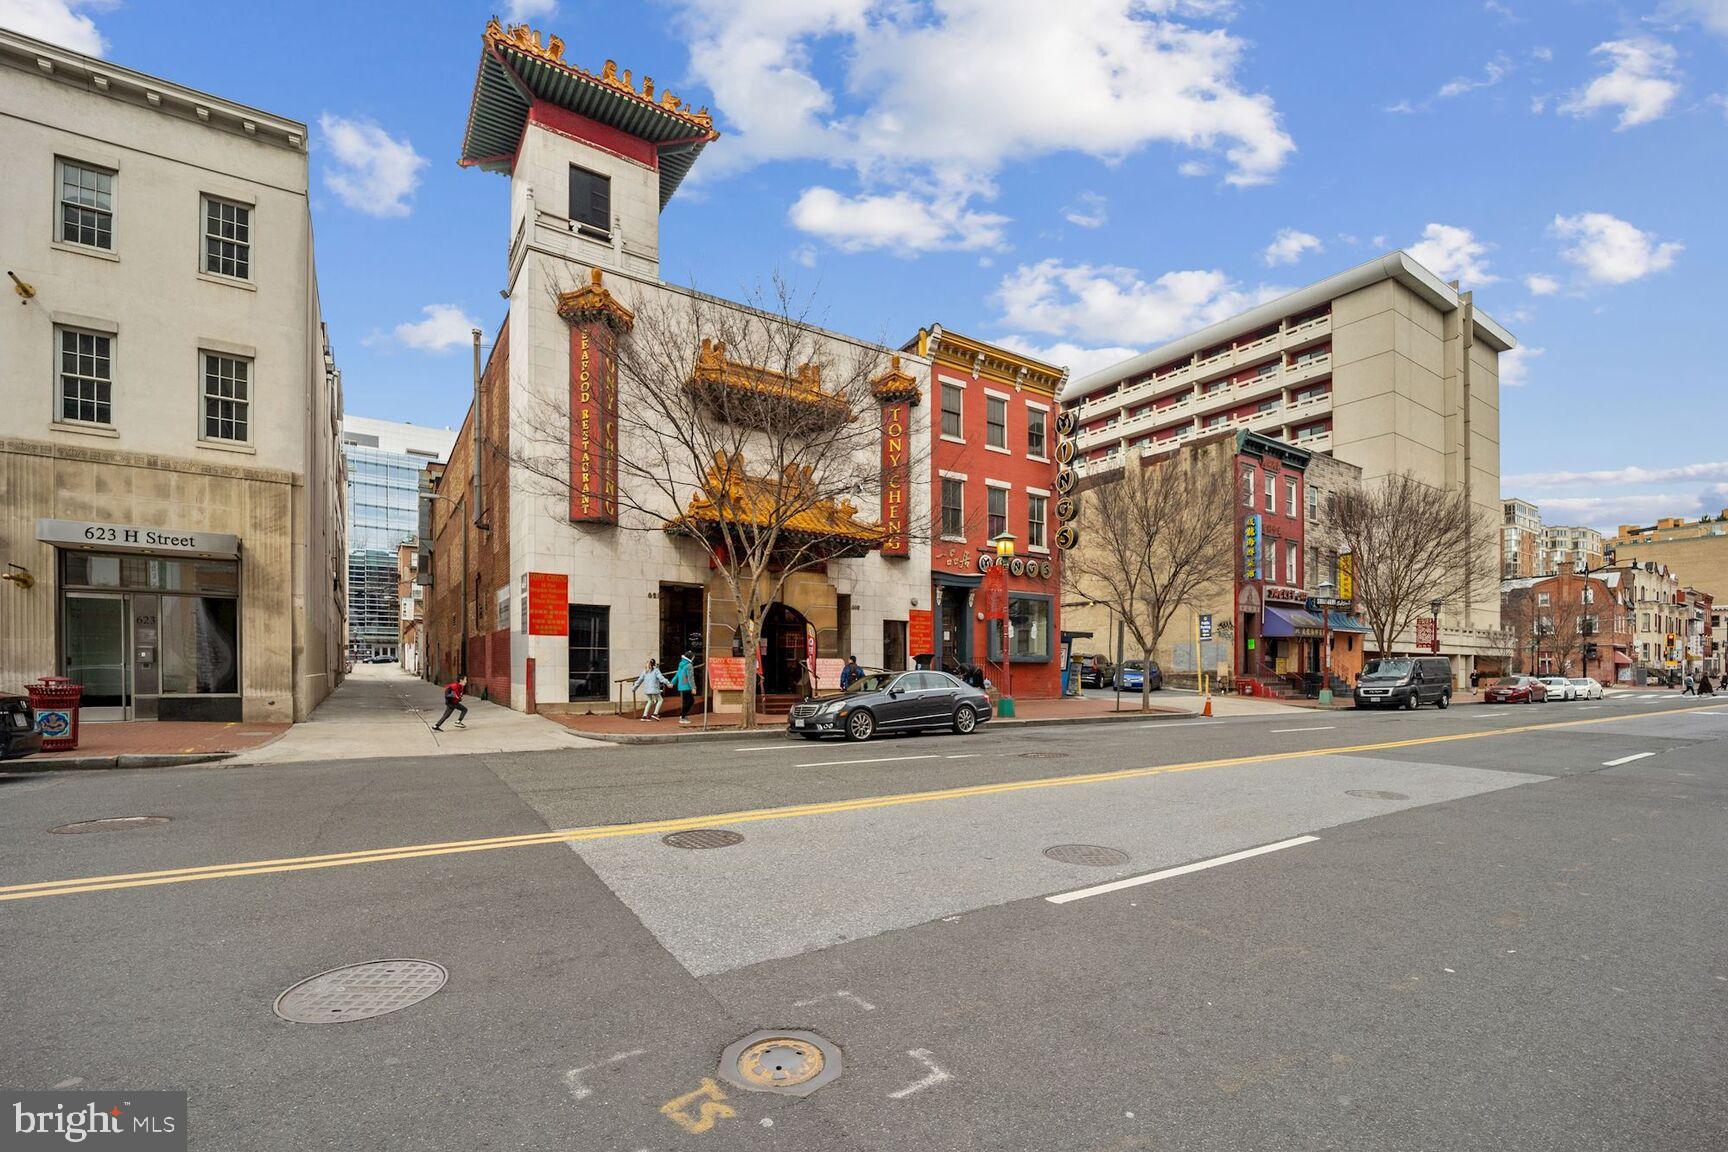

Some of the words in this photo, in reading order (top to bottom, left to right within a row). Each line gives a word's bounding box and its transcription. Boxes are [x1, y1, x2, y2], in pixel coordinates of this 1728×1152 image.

[580, 327, 590, 403] SEAFOOD
[581, 409, 590, 514] RESTAURANT
[888, 408, 902, 467] TONY
[888, 475, 902, 549] CHENG
[1056, 411, 1074, 548] MINGS
[84, 526, 117, 541] 623
[124, 530, 140, 543] H
[146, 531, 196, 547] Street
[136, 615, 156, 625] 623
